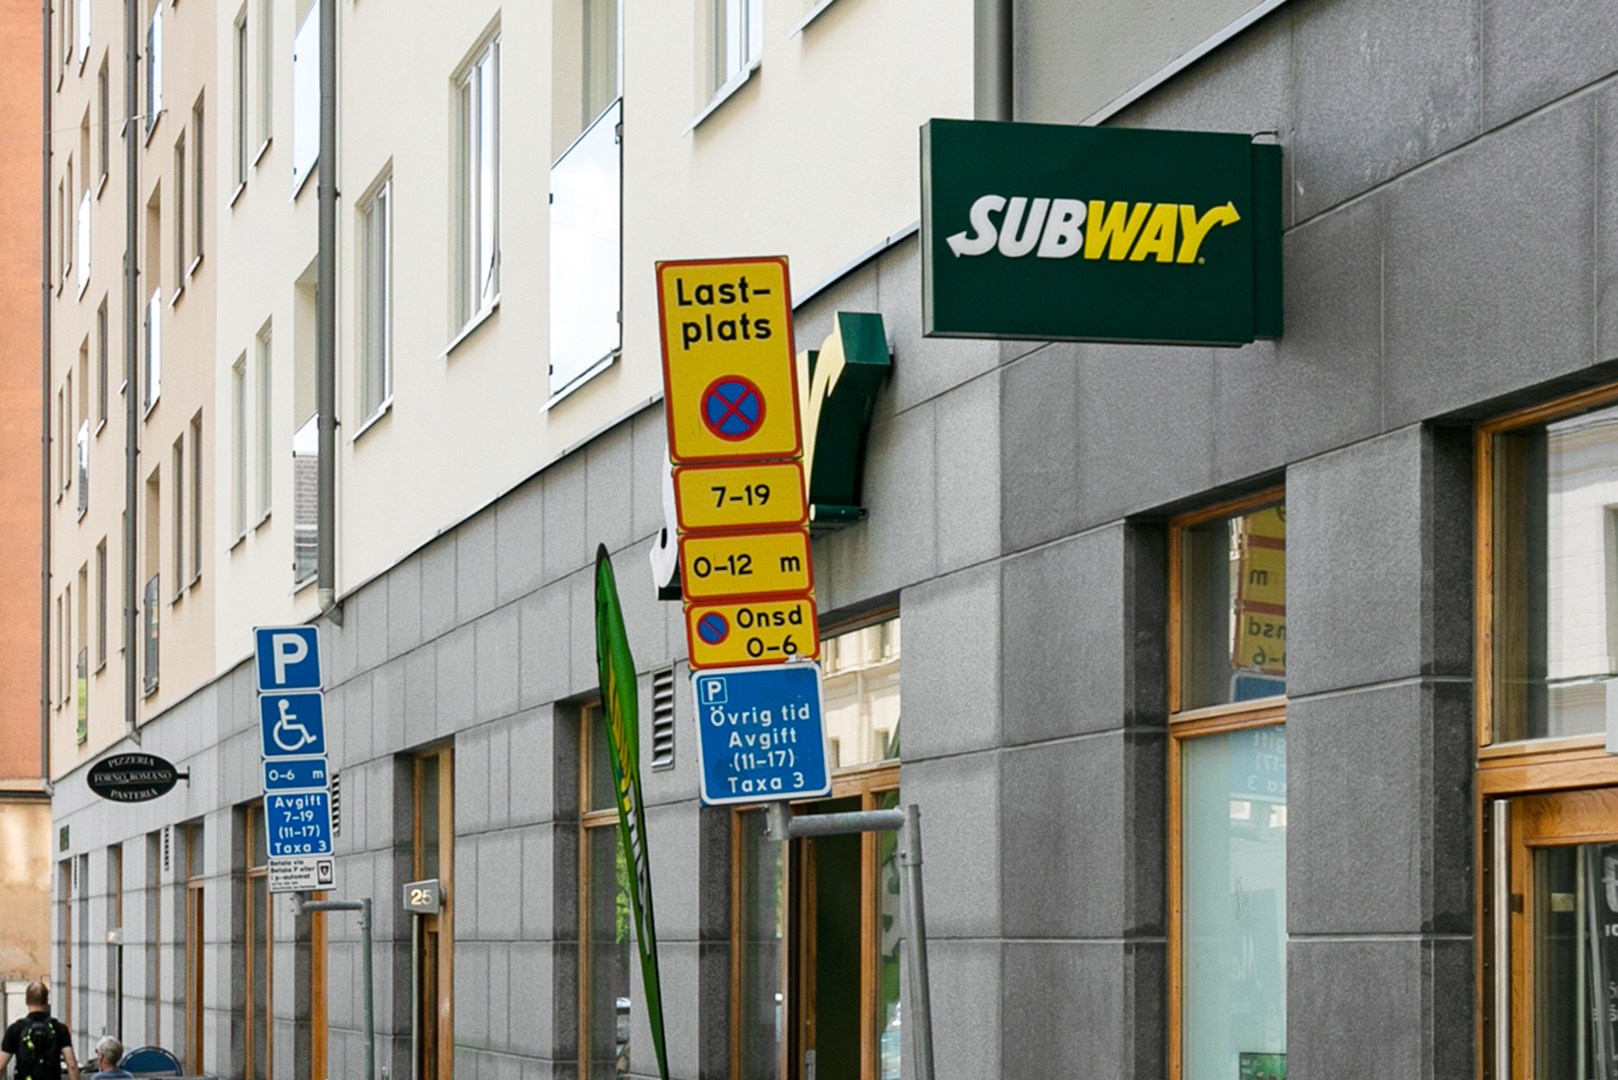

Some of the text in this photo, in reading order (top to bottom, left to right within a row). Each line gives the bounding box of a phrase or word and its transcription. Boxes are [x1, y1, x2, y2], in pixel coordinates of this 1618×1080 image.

[946, 194, 1241, 264] SUBWAY
[676, 276, 771, 306] Last-
[682, 313, 772, 350] plats
[711, 484, 770, 508] 7-19
[693, 553, 800, 578] 0-12 m
[736, 604, 803, 629] Onsd
[746, 635, 798, 658] 0-6
[272, 633, 308, 685] P
[707, 680, 722, 702] P
[710, 703, 811, 727] Övrig tid
[729, 727, 797, 750] Avgift
[107, 755, 154, 768] PIZZERIA
[733, 748, 795, 772] (11-17)
[268, 769, 324, 781] 0-6 m
[727, 772, 805, 794] Taxa 3
[110, 788, 158, 800] PASTERIA
[274, 795, 322, 810] Avgift
[284, 811, 314, 823] 7-19
[278, 824, 321, 840] (11-17)
[274, 840, 327, 855] Taxa 3
[411, 889, 432, 905] 25
